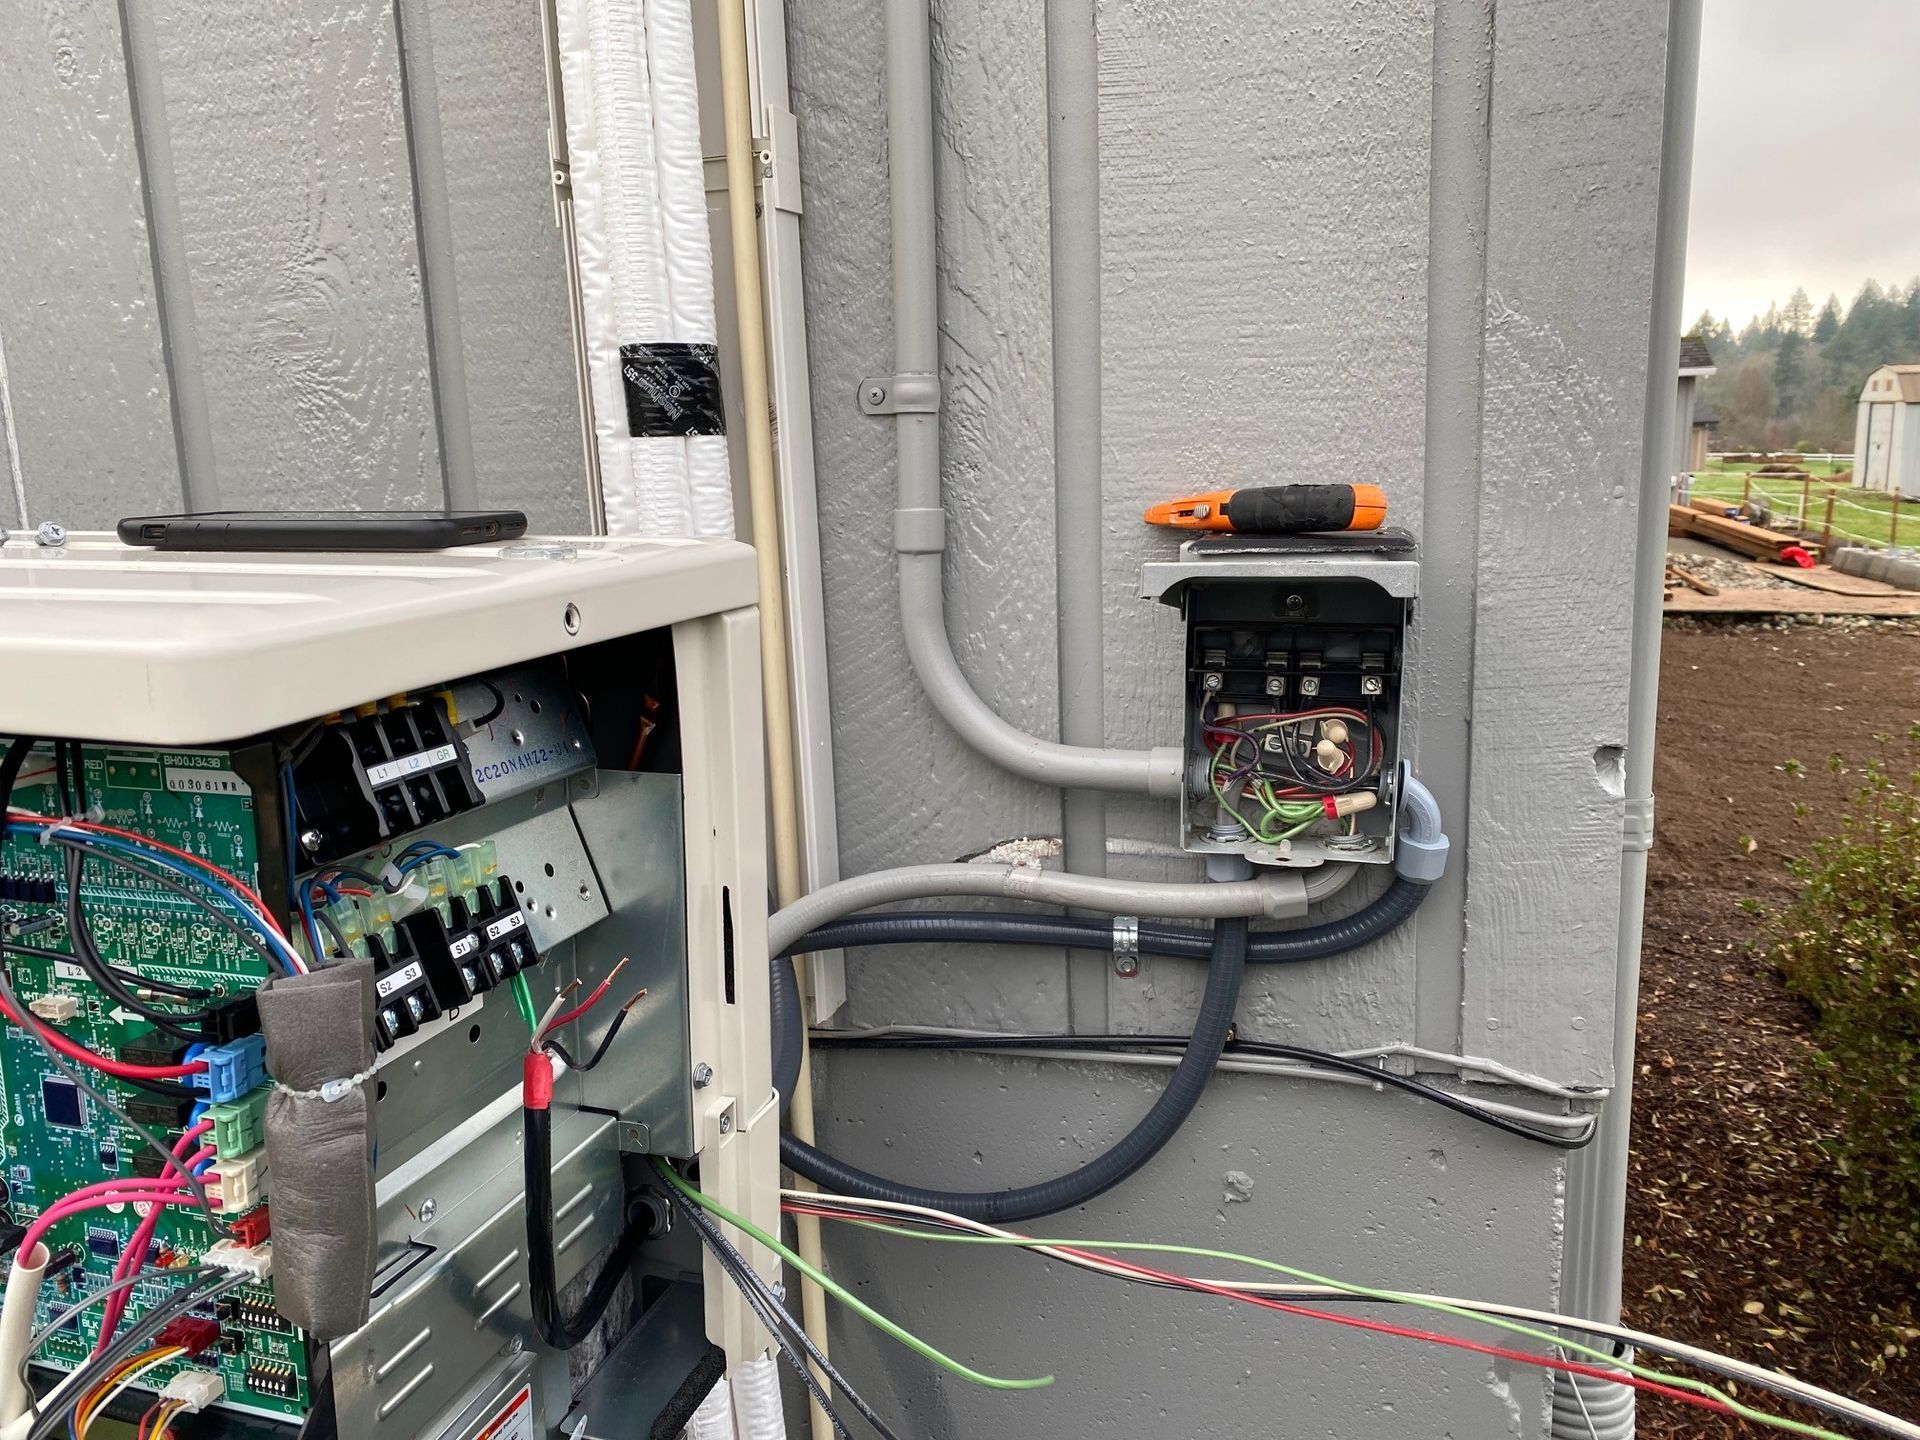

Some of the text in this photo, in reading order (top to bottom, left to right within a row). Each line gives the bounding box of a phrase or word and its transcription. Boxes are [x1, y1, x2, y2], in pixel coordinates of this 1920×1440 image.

[623, 364, 639, 382] 557
[637, 377, 681, 421] Nashua
[84, 760, 103, 770] RED
[377, 748, 450, 778] L1 L2 GR
[490, 916, 520, 937] S2 S3
[455, 944, 466, 954] S1
[108, 958, 132, 966] BOARD
[380, 968, 417, 994] S2 S3
[22, 990, 39, 1001] WHT
[82, 1318, 98, 1329] BLK
[54, 1359, 72, 1370] BLU
